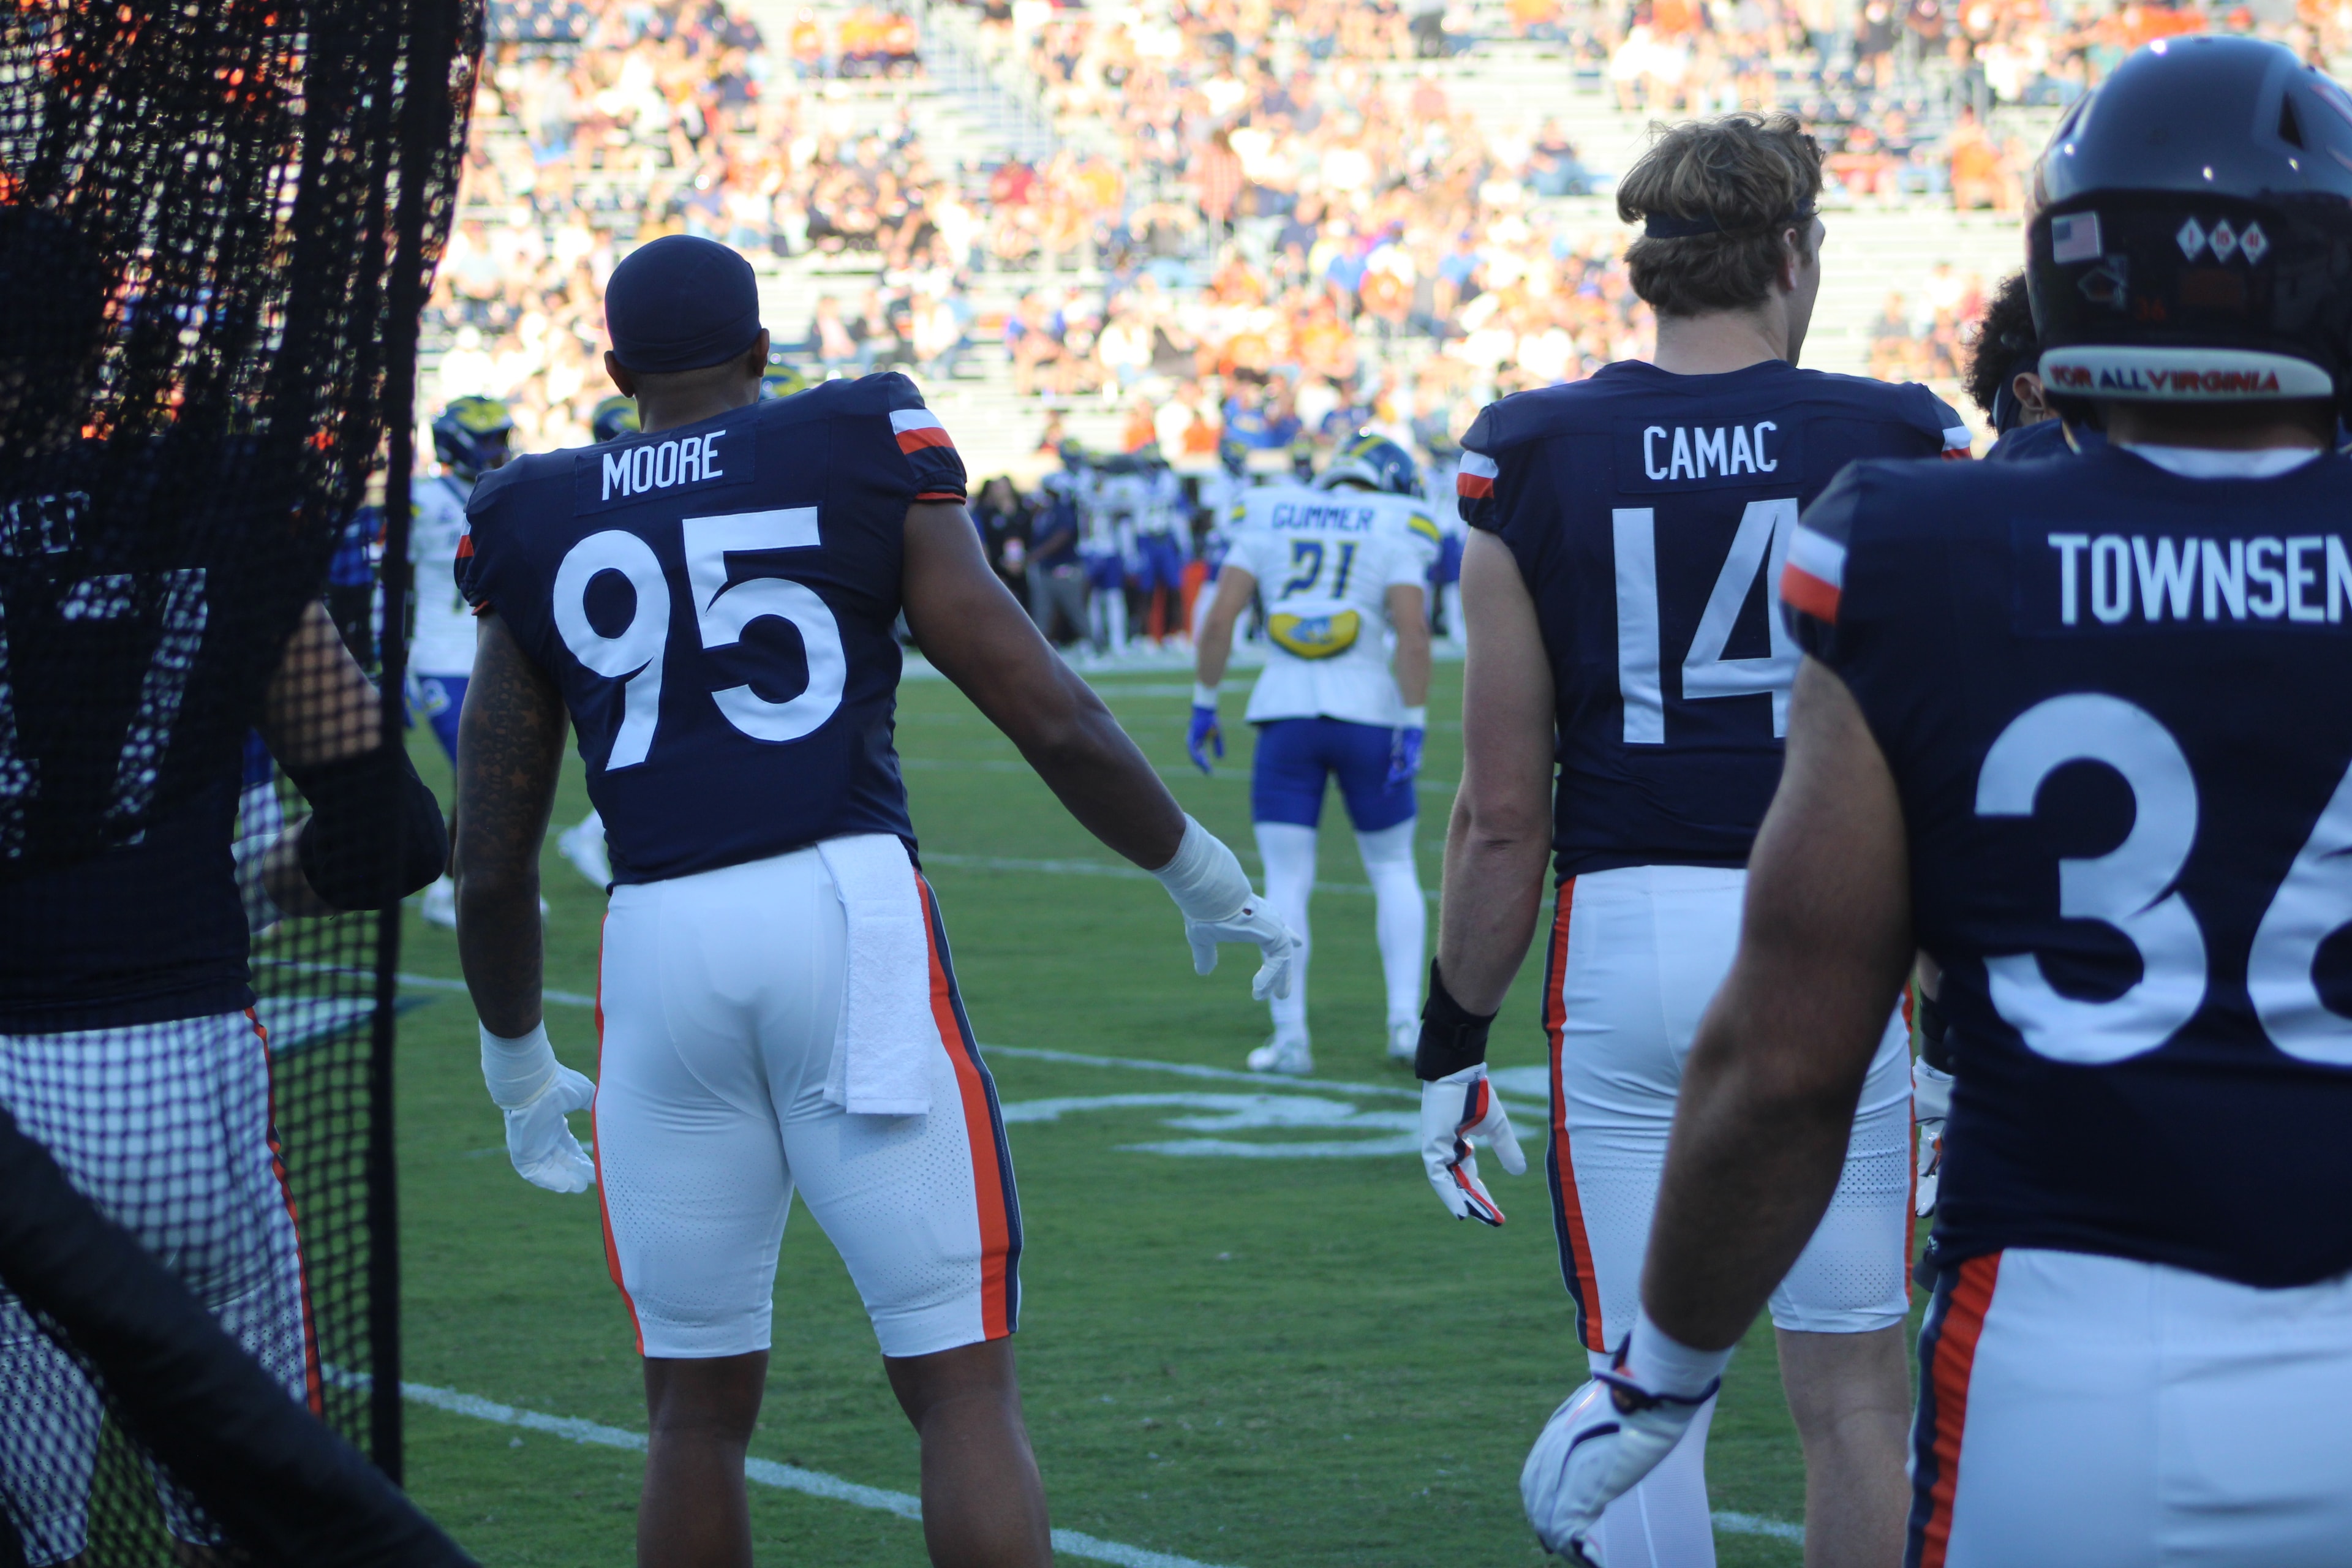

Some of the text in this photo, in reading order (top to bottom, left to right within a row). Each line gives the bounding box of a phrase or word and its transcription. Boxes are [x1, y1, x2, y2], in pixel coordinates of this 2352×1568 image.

[2099, 368, 2148, 391] ALL
[2146, 370, 2280, 393] VIRGINIA
[601, 429, 726, 501] MOORE
[1643, 421, 1777, 480] CAMAC
[1272, 502, 1376, 532] GUMMER
[1277, 538, 1359, 602] 21
[552, 505, 847, 772] 95
[1611, 497, 1804, 744] 14
